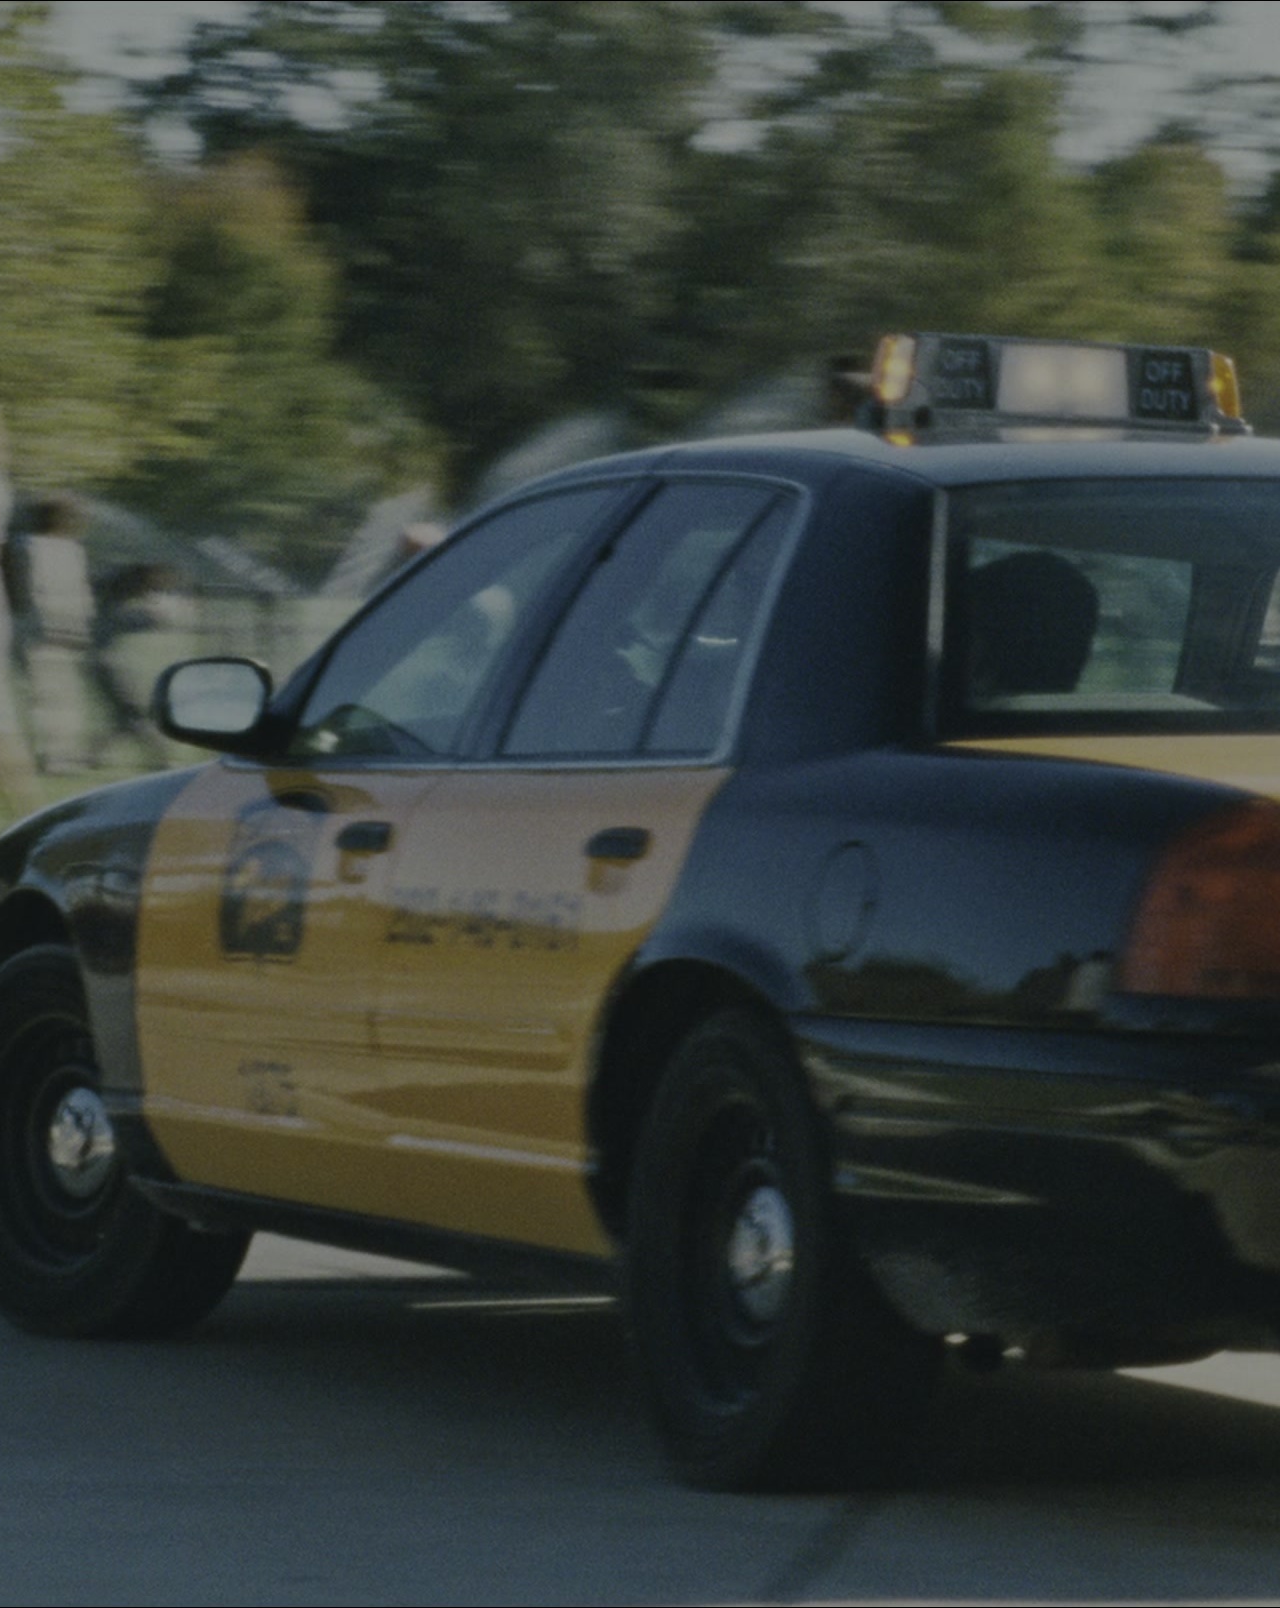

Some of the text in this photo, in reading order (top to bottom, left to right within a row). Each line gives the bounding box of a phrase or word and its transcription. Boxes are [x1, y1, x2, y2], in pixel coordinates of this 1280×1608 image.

[943, 348, 981, 371] OFF
[1144, 360, 1183, 383] OFF
[934, 376, 983, 400] DUTY
[1140, 387, 1190, 411] DUTY
